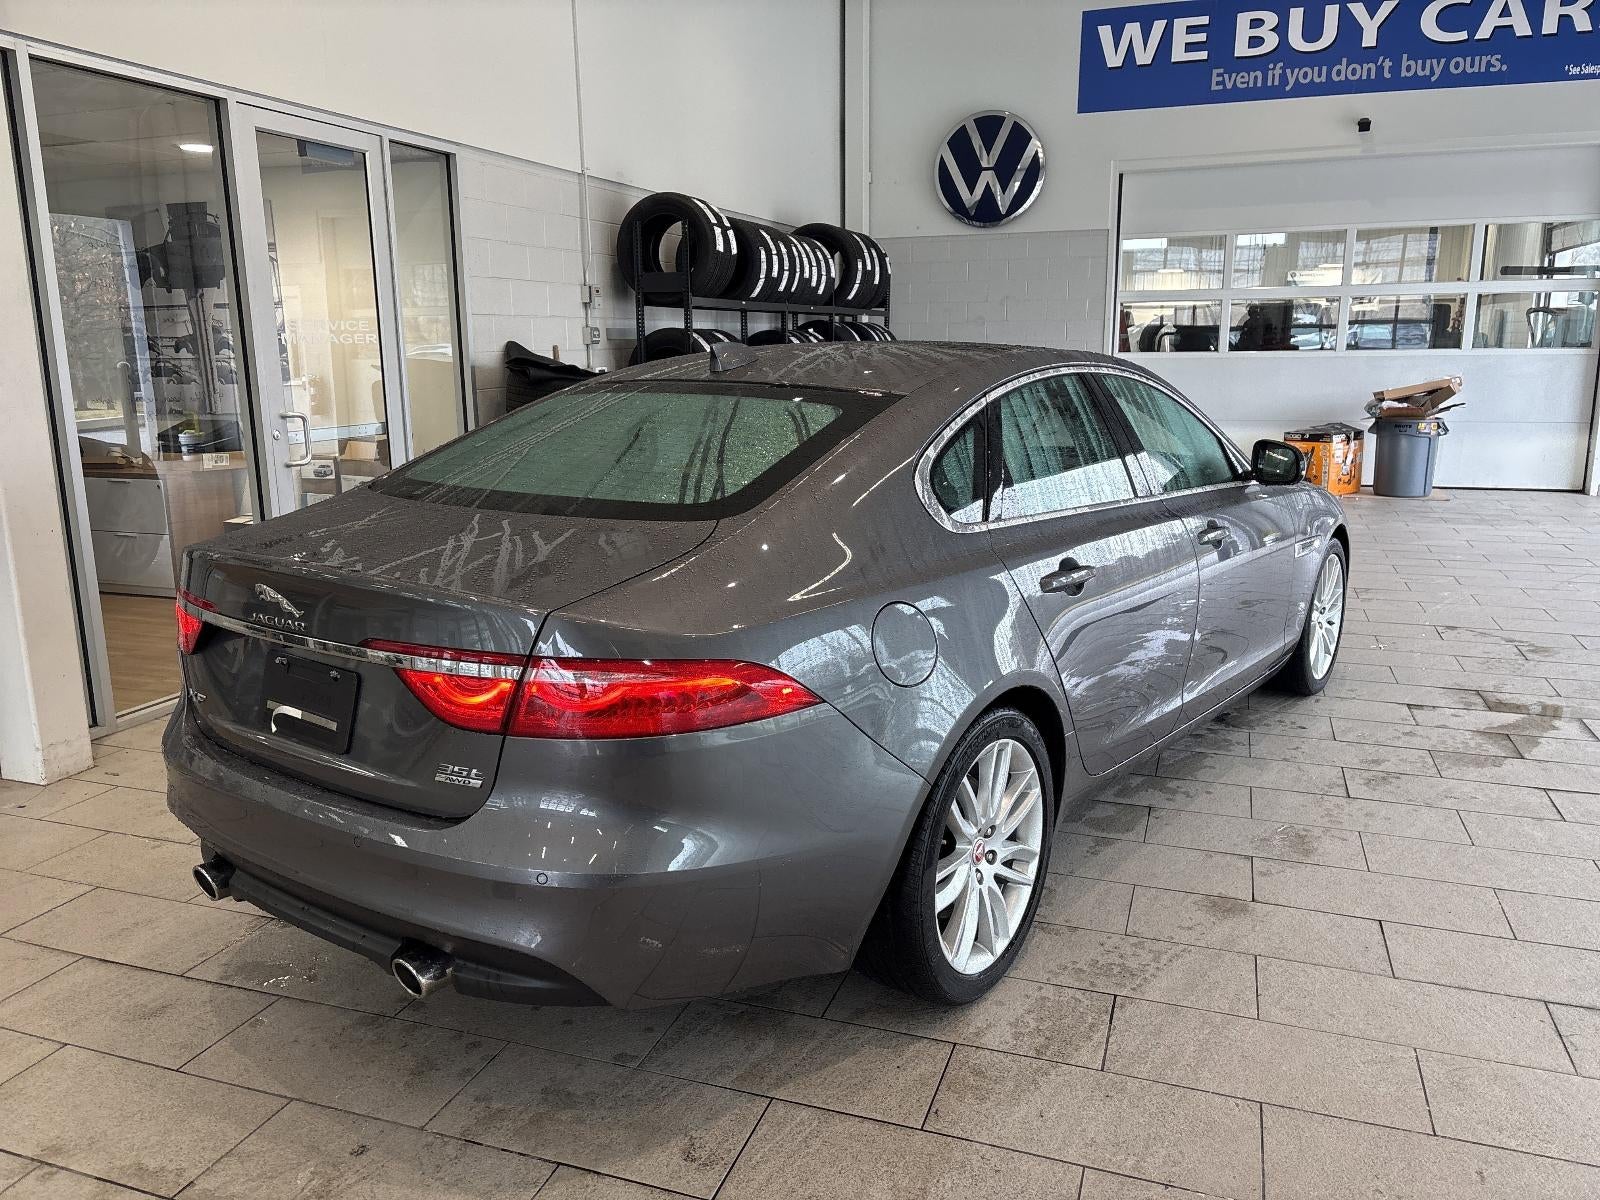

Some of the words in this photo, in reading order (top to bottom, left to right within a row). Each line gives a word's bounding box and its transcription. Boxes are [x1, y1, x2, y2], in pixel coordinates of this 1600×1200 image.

[1097, 15, 1210, 68] WE
[1235, 0, 1398, 57] BUY
[1210, 67, 1263, 91] Even
[1267, 63, 1282, 86] if
[1284, 64, 1327, 92] you
[1331, 57, 1392, 81] don't
[1401, 53, 1446, 82] buy
[1449, 54, 1508, 75] ours.
[281, 332, 377, 345] MANAGER
[248, 612, 305, 631] JAGUAR
[445, 776, 471, 785] AWD
